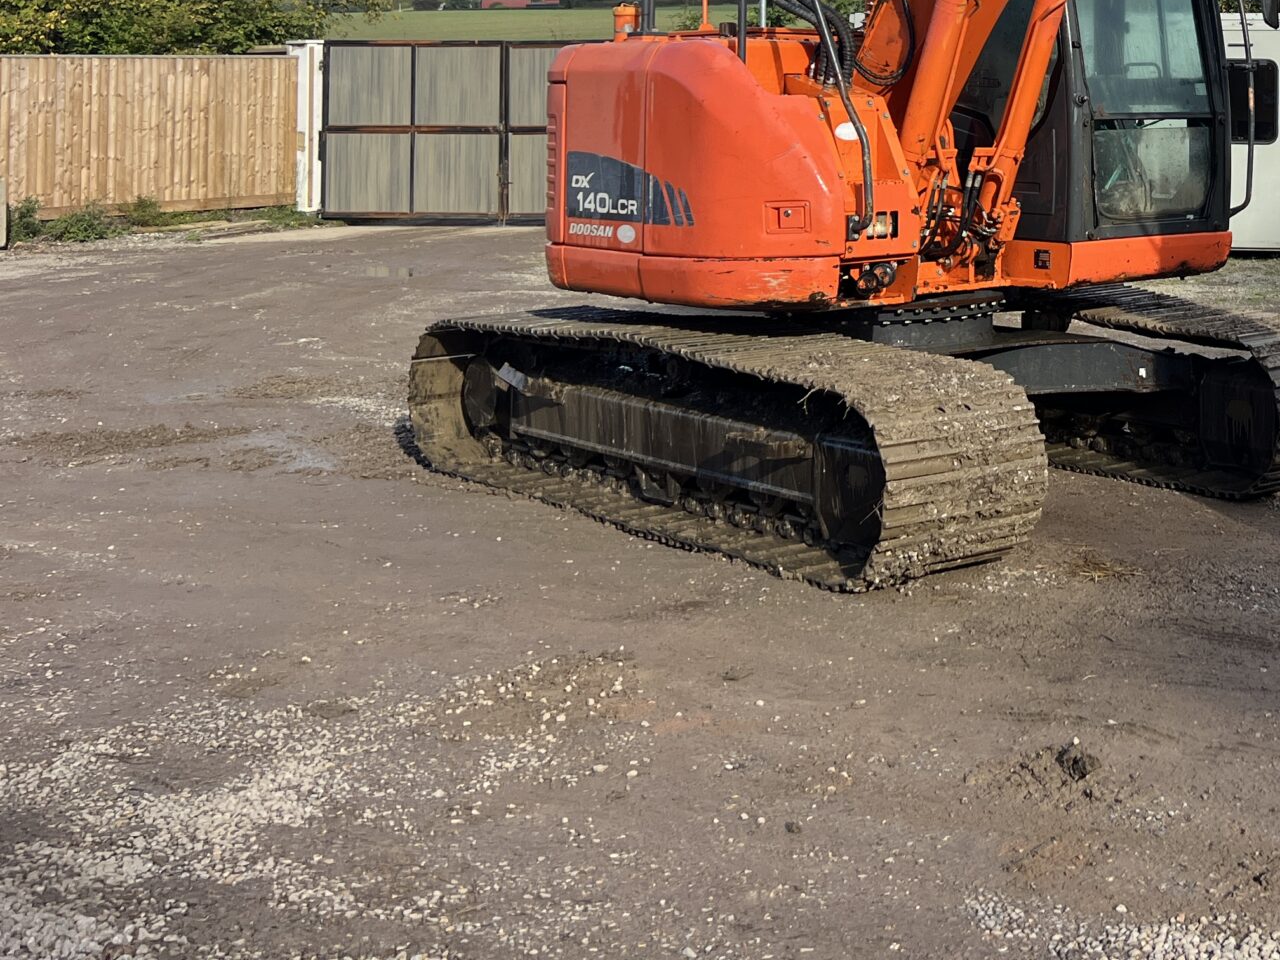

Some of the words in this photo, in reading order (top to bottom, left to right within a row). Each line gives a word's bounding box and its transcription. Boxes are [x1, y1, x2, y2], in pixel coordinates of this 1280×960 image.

[571, 172, 595, 188] DX
[577, 191, 638, 215] 140LCR
[569, 223, 614, 237] DOOSAN
